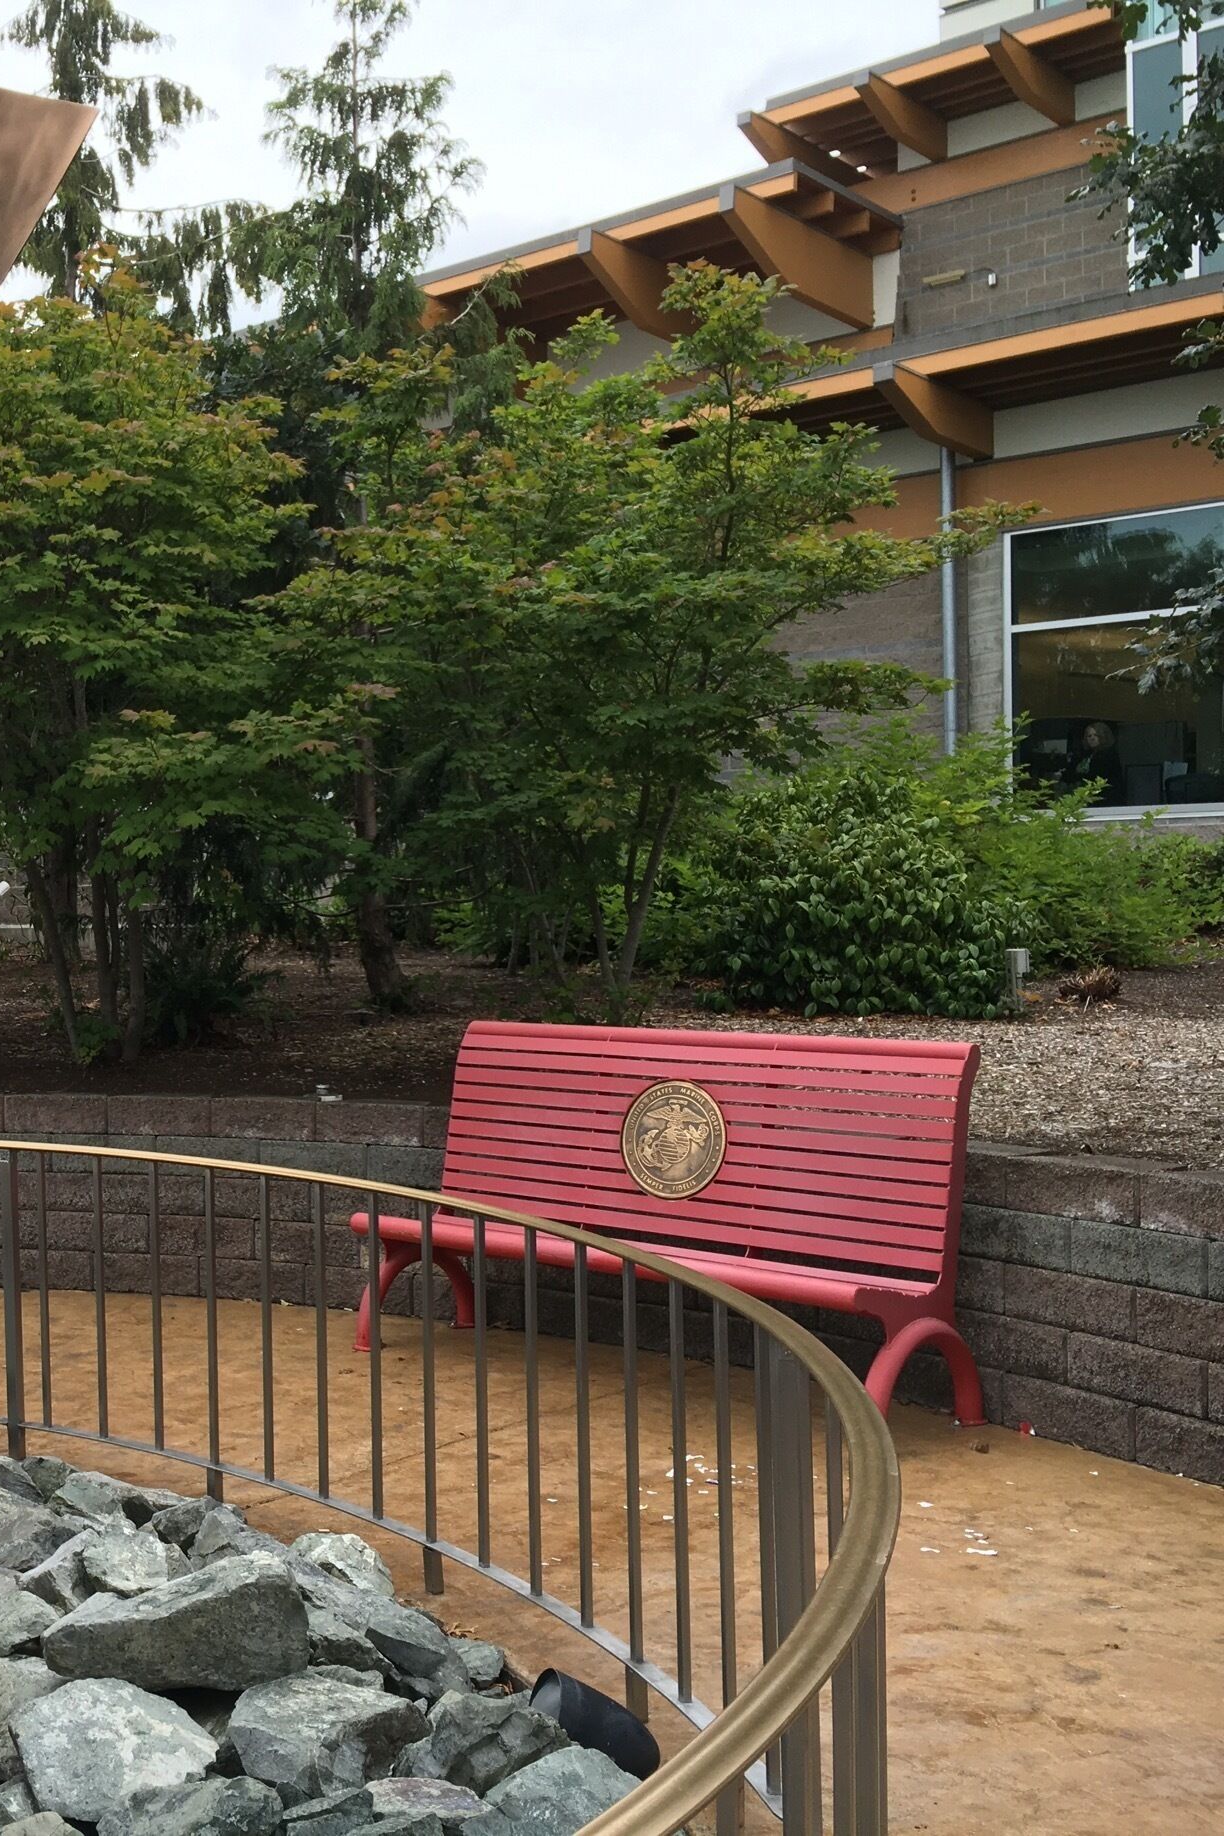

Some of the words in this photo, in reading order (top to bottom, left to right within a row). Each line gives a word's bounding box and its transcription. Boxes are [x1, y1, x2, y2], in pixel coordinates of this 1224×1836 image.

[629, 1103, 645, 1129] UNITED
[649, 1087, 673, 1100] STATES
[680, 1087, 706, 1105] MARINE
[708, 1110, 720, 1136] CORPS
[640, 1172, 663, 1190] SEMPER
[672, 1180, 697, 1191] FIDELIS
